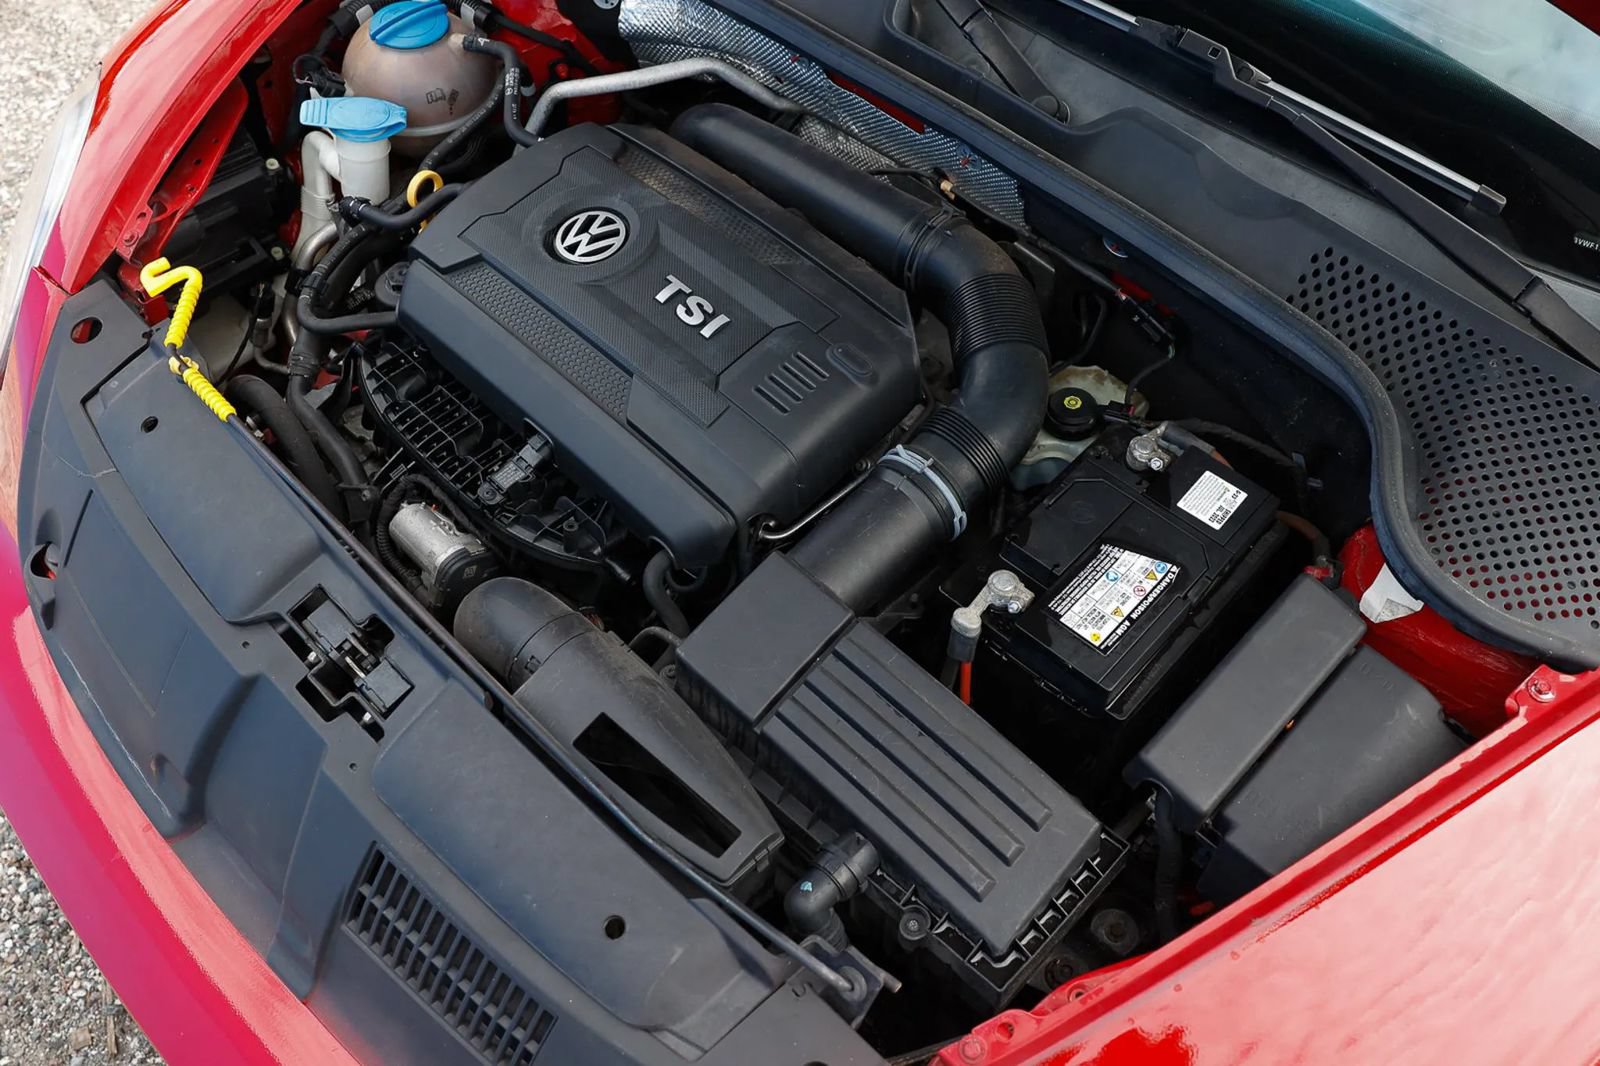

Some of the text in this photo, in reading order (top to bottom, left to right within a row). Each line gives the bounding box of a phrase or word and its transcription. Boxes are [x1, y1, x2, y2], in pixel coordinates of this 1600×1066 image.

[556, 211, 626, 263] VW
[655, 274, 731, 339] TSI
[1115, 619, 1131, 635] AGM
